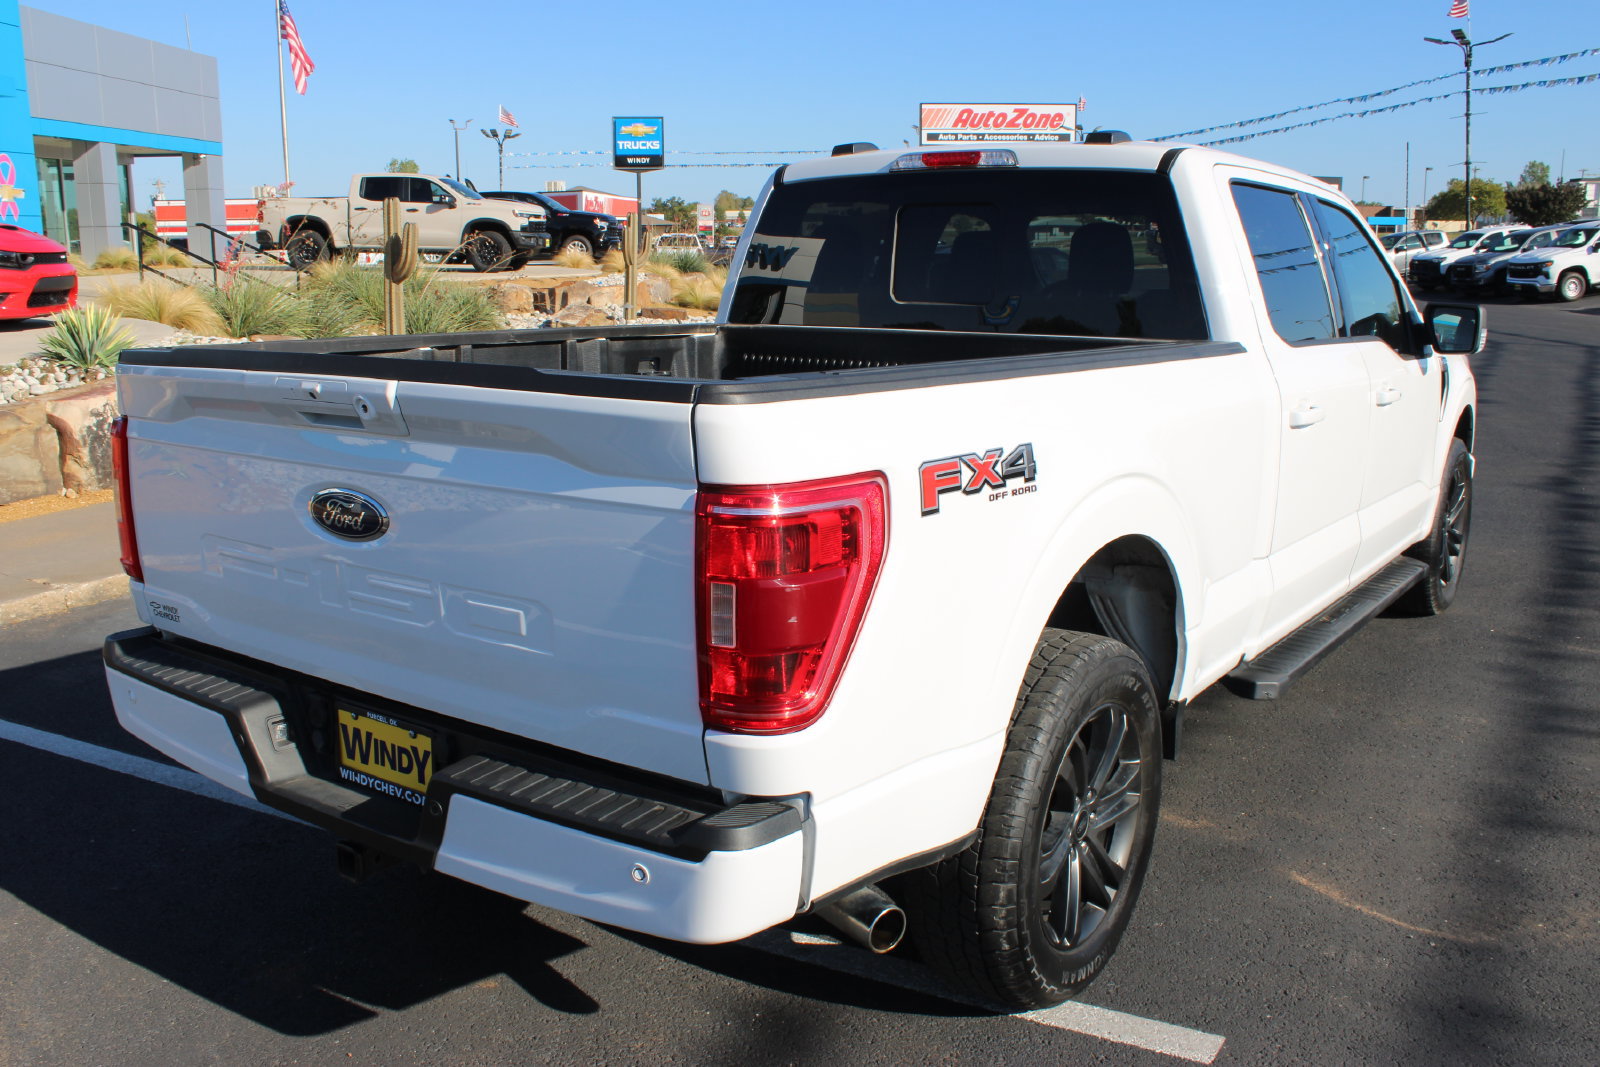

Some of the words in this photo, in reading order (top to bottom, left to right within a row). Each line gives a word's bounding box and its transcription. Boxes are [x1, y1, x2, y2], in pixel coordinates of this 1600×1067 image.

[952, 107, 1065, 130] AutoZone
[617, 140, 660, 150] TRUCKS
[918, 442, 1037, 517] FX4
[988, 492, 1009, 502] OFF
[1011, 484, 1038, 497] ROAD
[322, 498, 366, 531] Ford
[340, 723, 431, 785] WINDY
